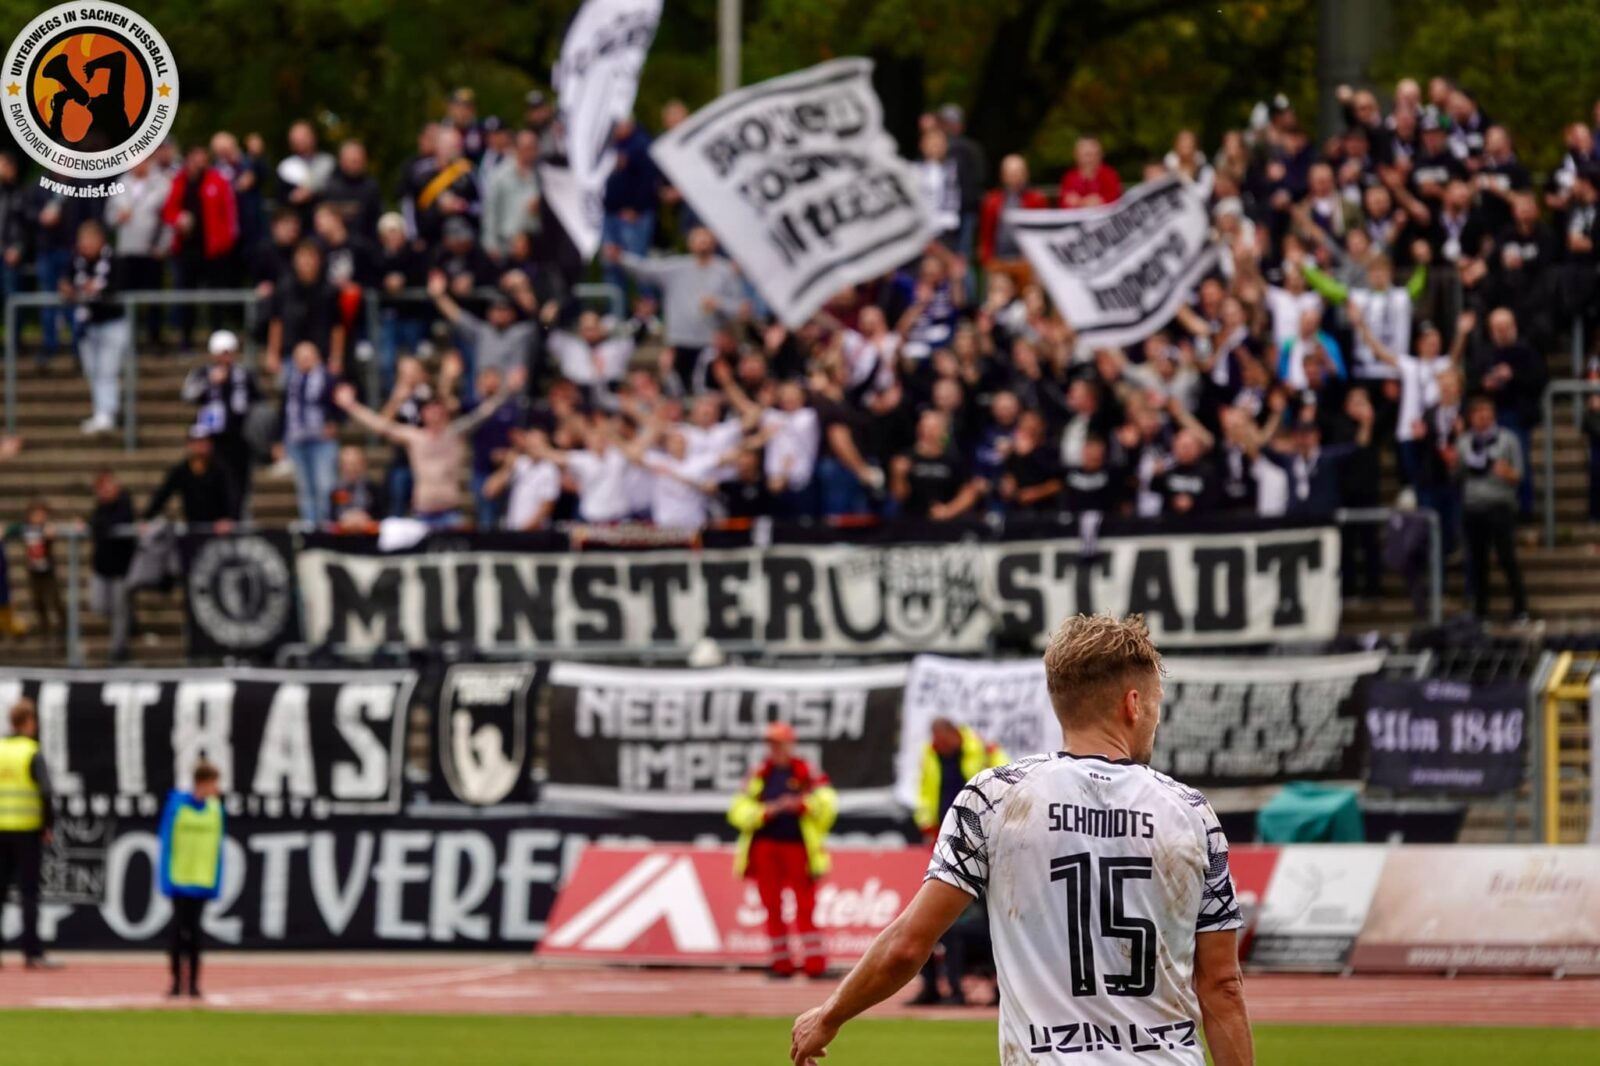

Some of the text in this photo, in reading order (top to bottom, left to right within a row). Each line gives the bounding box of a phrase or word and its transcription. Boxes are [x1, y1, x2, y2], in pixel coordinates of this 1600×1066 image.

[999, 540, 1323, 634] STADT
[574, 687, 868, 741] NEBULOSA
[1048, 803, 1154, 839] SCHMIDTS
[1050, 851, 1157, 997] 15
[1029, 1020, 1196, 1053] UZIN UTZ
